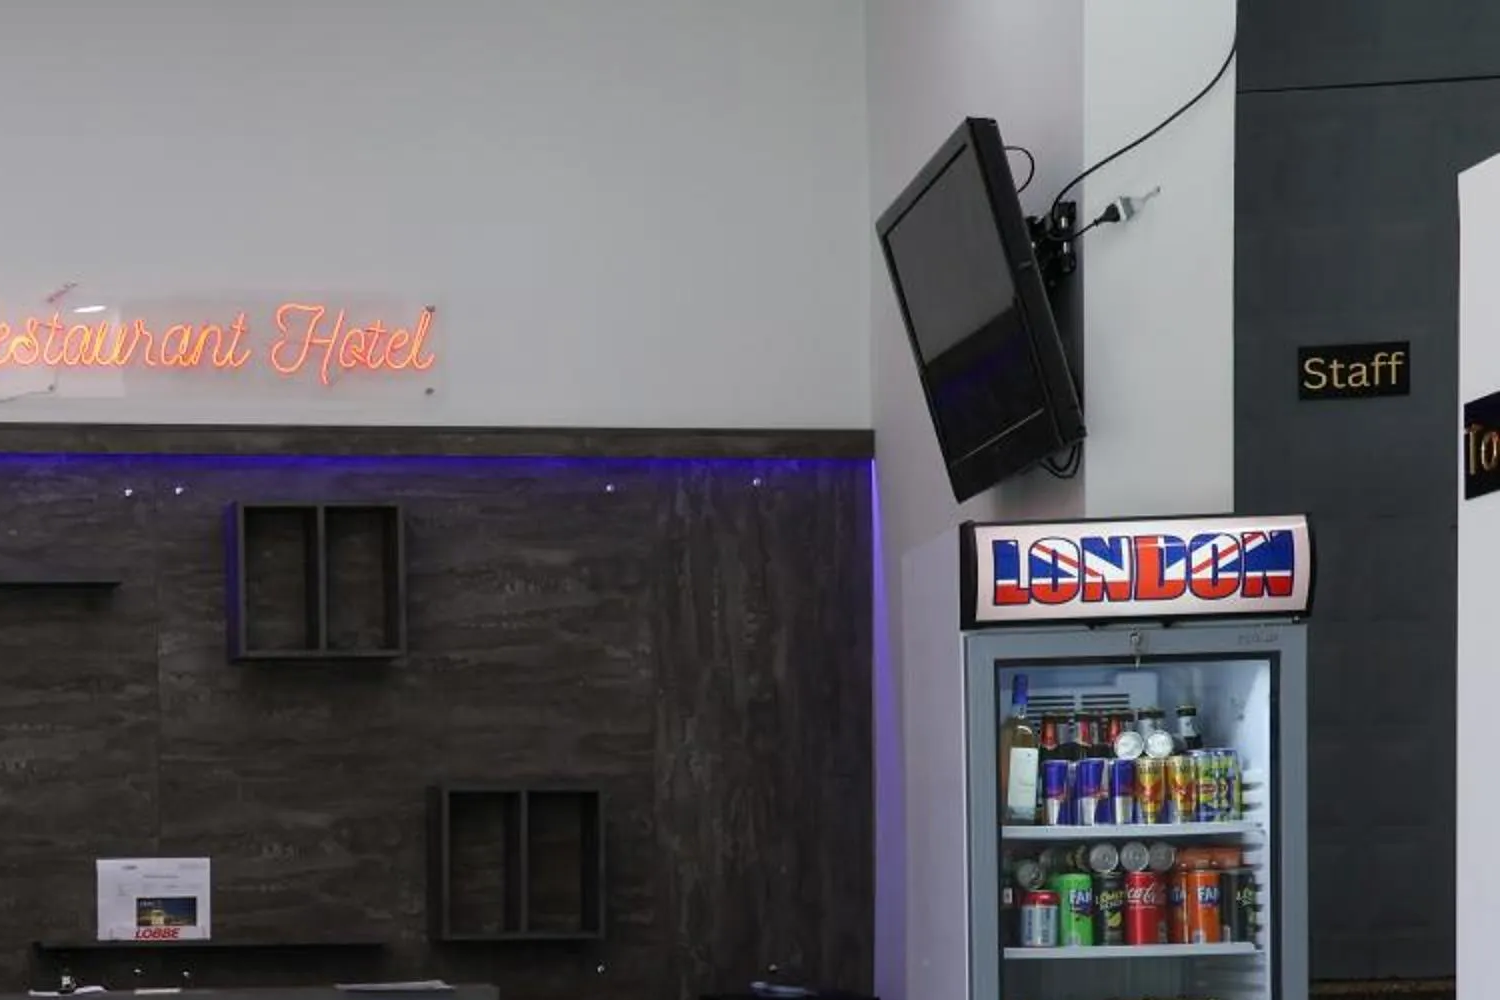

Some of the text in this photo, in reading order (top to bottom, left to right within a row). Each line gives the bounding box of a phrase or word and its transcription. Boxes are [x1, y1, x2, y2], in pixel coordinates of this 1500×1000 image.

[271, 303, 436, 386] Hotel
[1303, 351, 1406, 390] Staff
[991, 529, 1297, 607] LONDON
